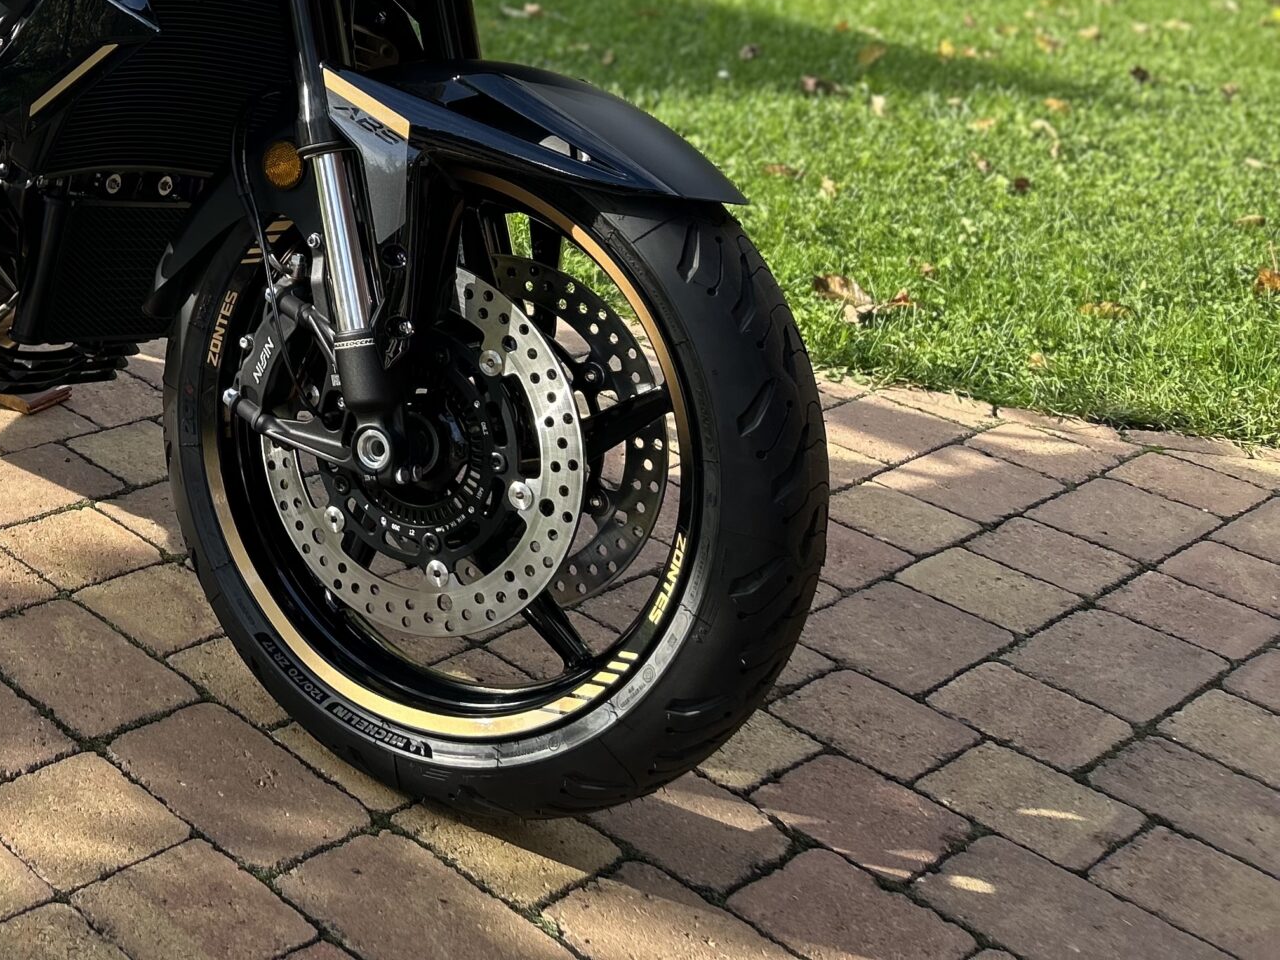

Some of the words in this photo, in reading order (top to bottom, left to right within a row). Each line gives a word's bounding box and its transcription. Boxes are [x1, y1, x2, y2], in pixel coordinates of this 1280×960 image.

[207, 290, 238, 368] ZONTES
[252, 336, 275, 385] NISSIN
[648, 532, 687, 626] ZONTES
[262, 641, 276, 652] 17
[273, 652, 290, 668] ZR
[288, 668, 324, 700] 120/70
[332, 705, 408, 748] MICHELIN
